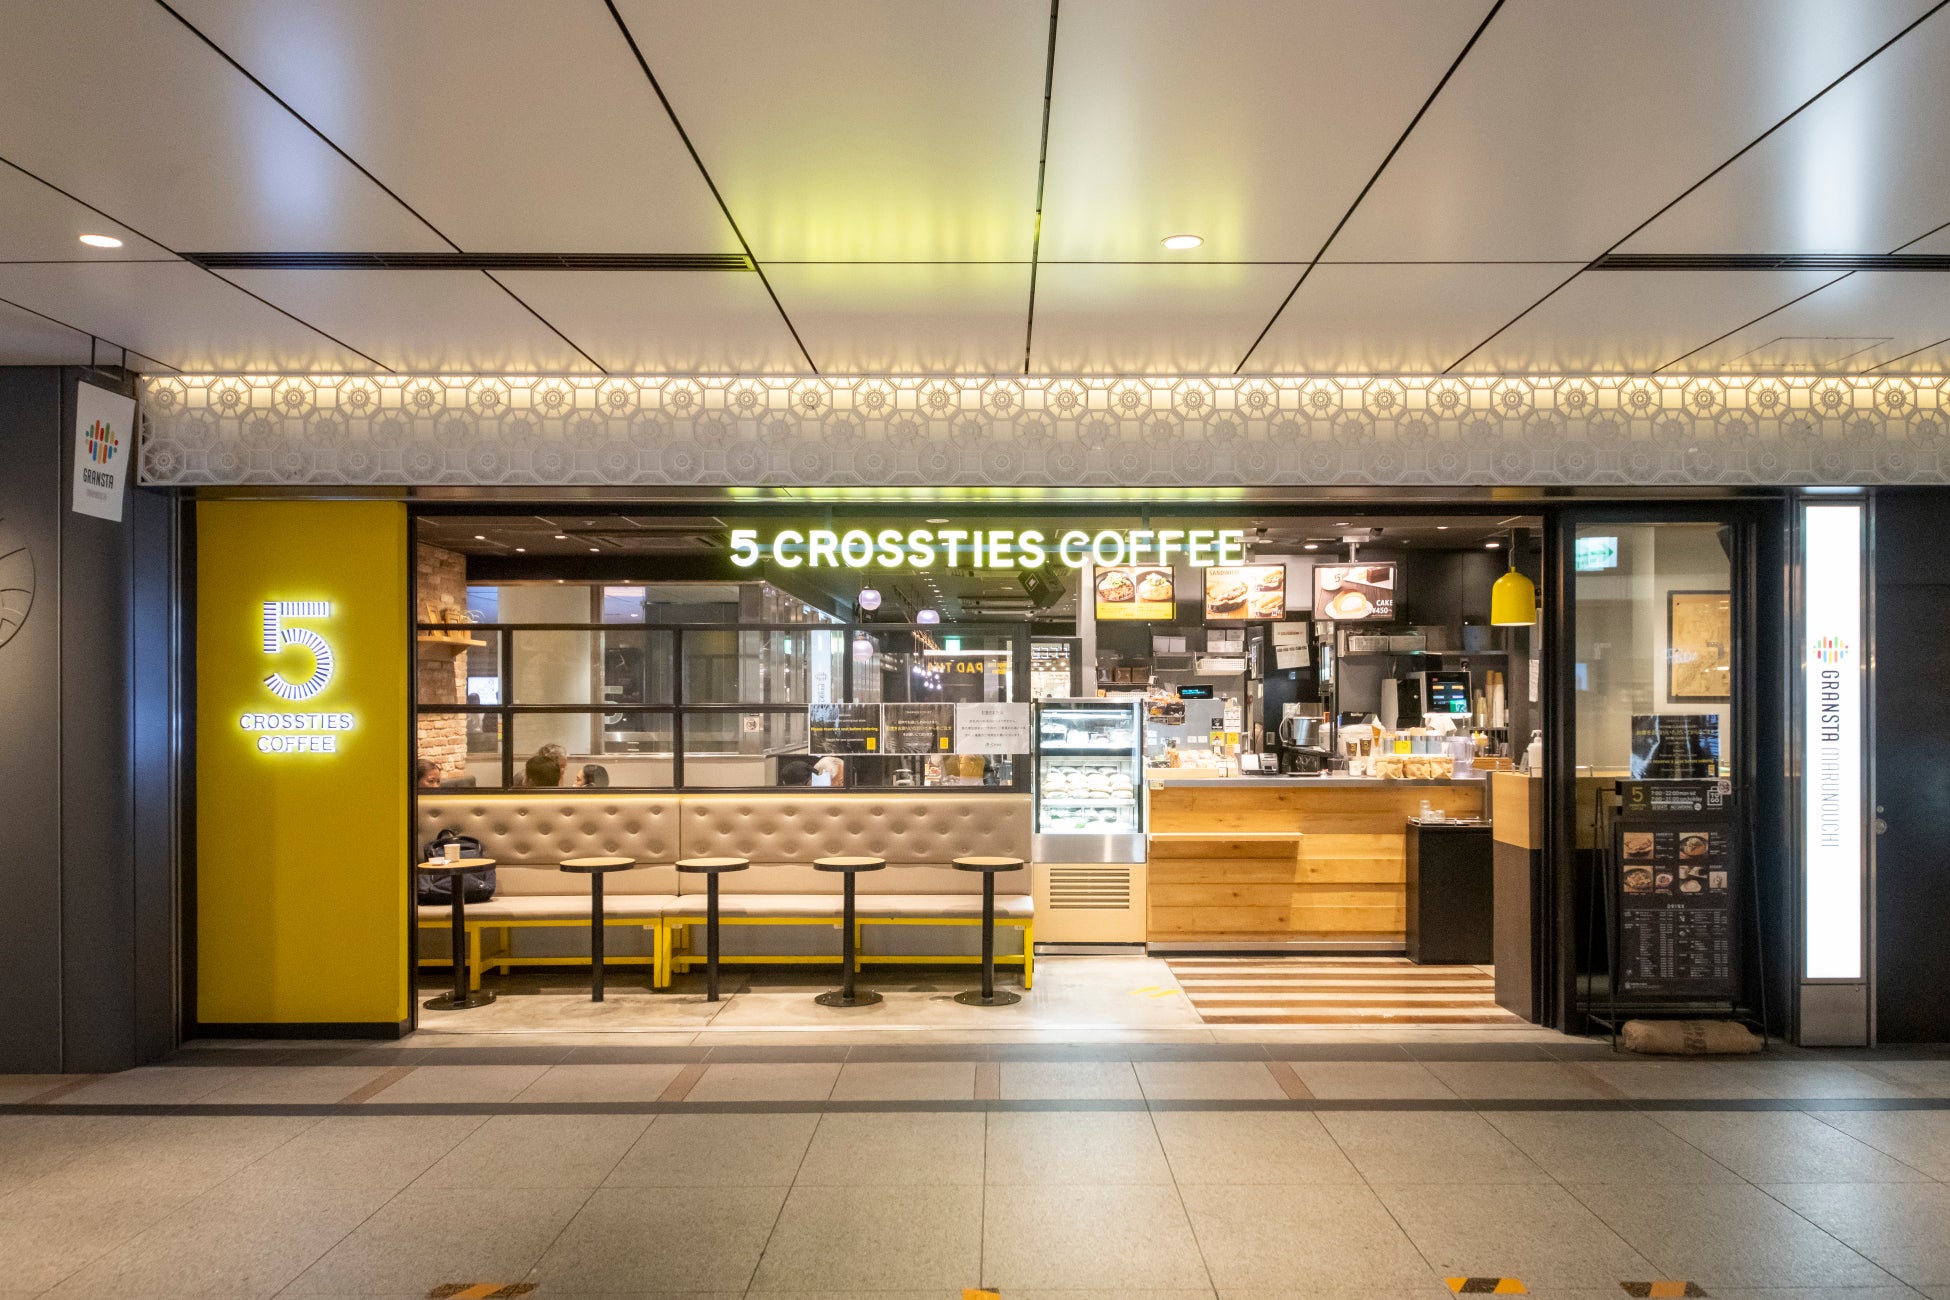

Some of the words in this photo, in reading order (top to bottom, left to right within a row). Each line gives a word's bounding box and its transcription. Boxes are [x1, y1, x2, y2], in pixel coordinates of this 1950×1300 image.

[83, 468, 114, 489] GRANSTA
[730, 529, 760, 567] 5
[773, 530, 1045, 568] CROSSTIES
[1060, 530, 1244, 568] COFFEE
[1376, 599, 1393, 607] CAKE
[263, 601, 335, 700] 5
[1821, 670, 1840, 742] GRANSTA
[240, 713, 353, 730] CROSSTIES
[257, 735, 336, 752] COFFEE
[1632, 786, 1643, 802] 5
[1821, 747, 1840, 847] MARUNOUCHI
